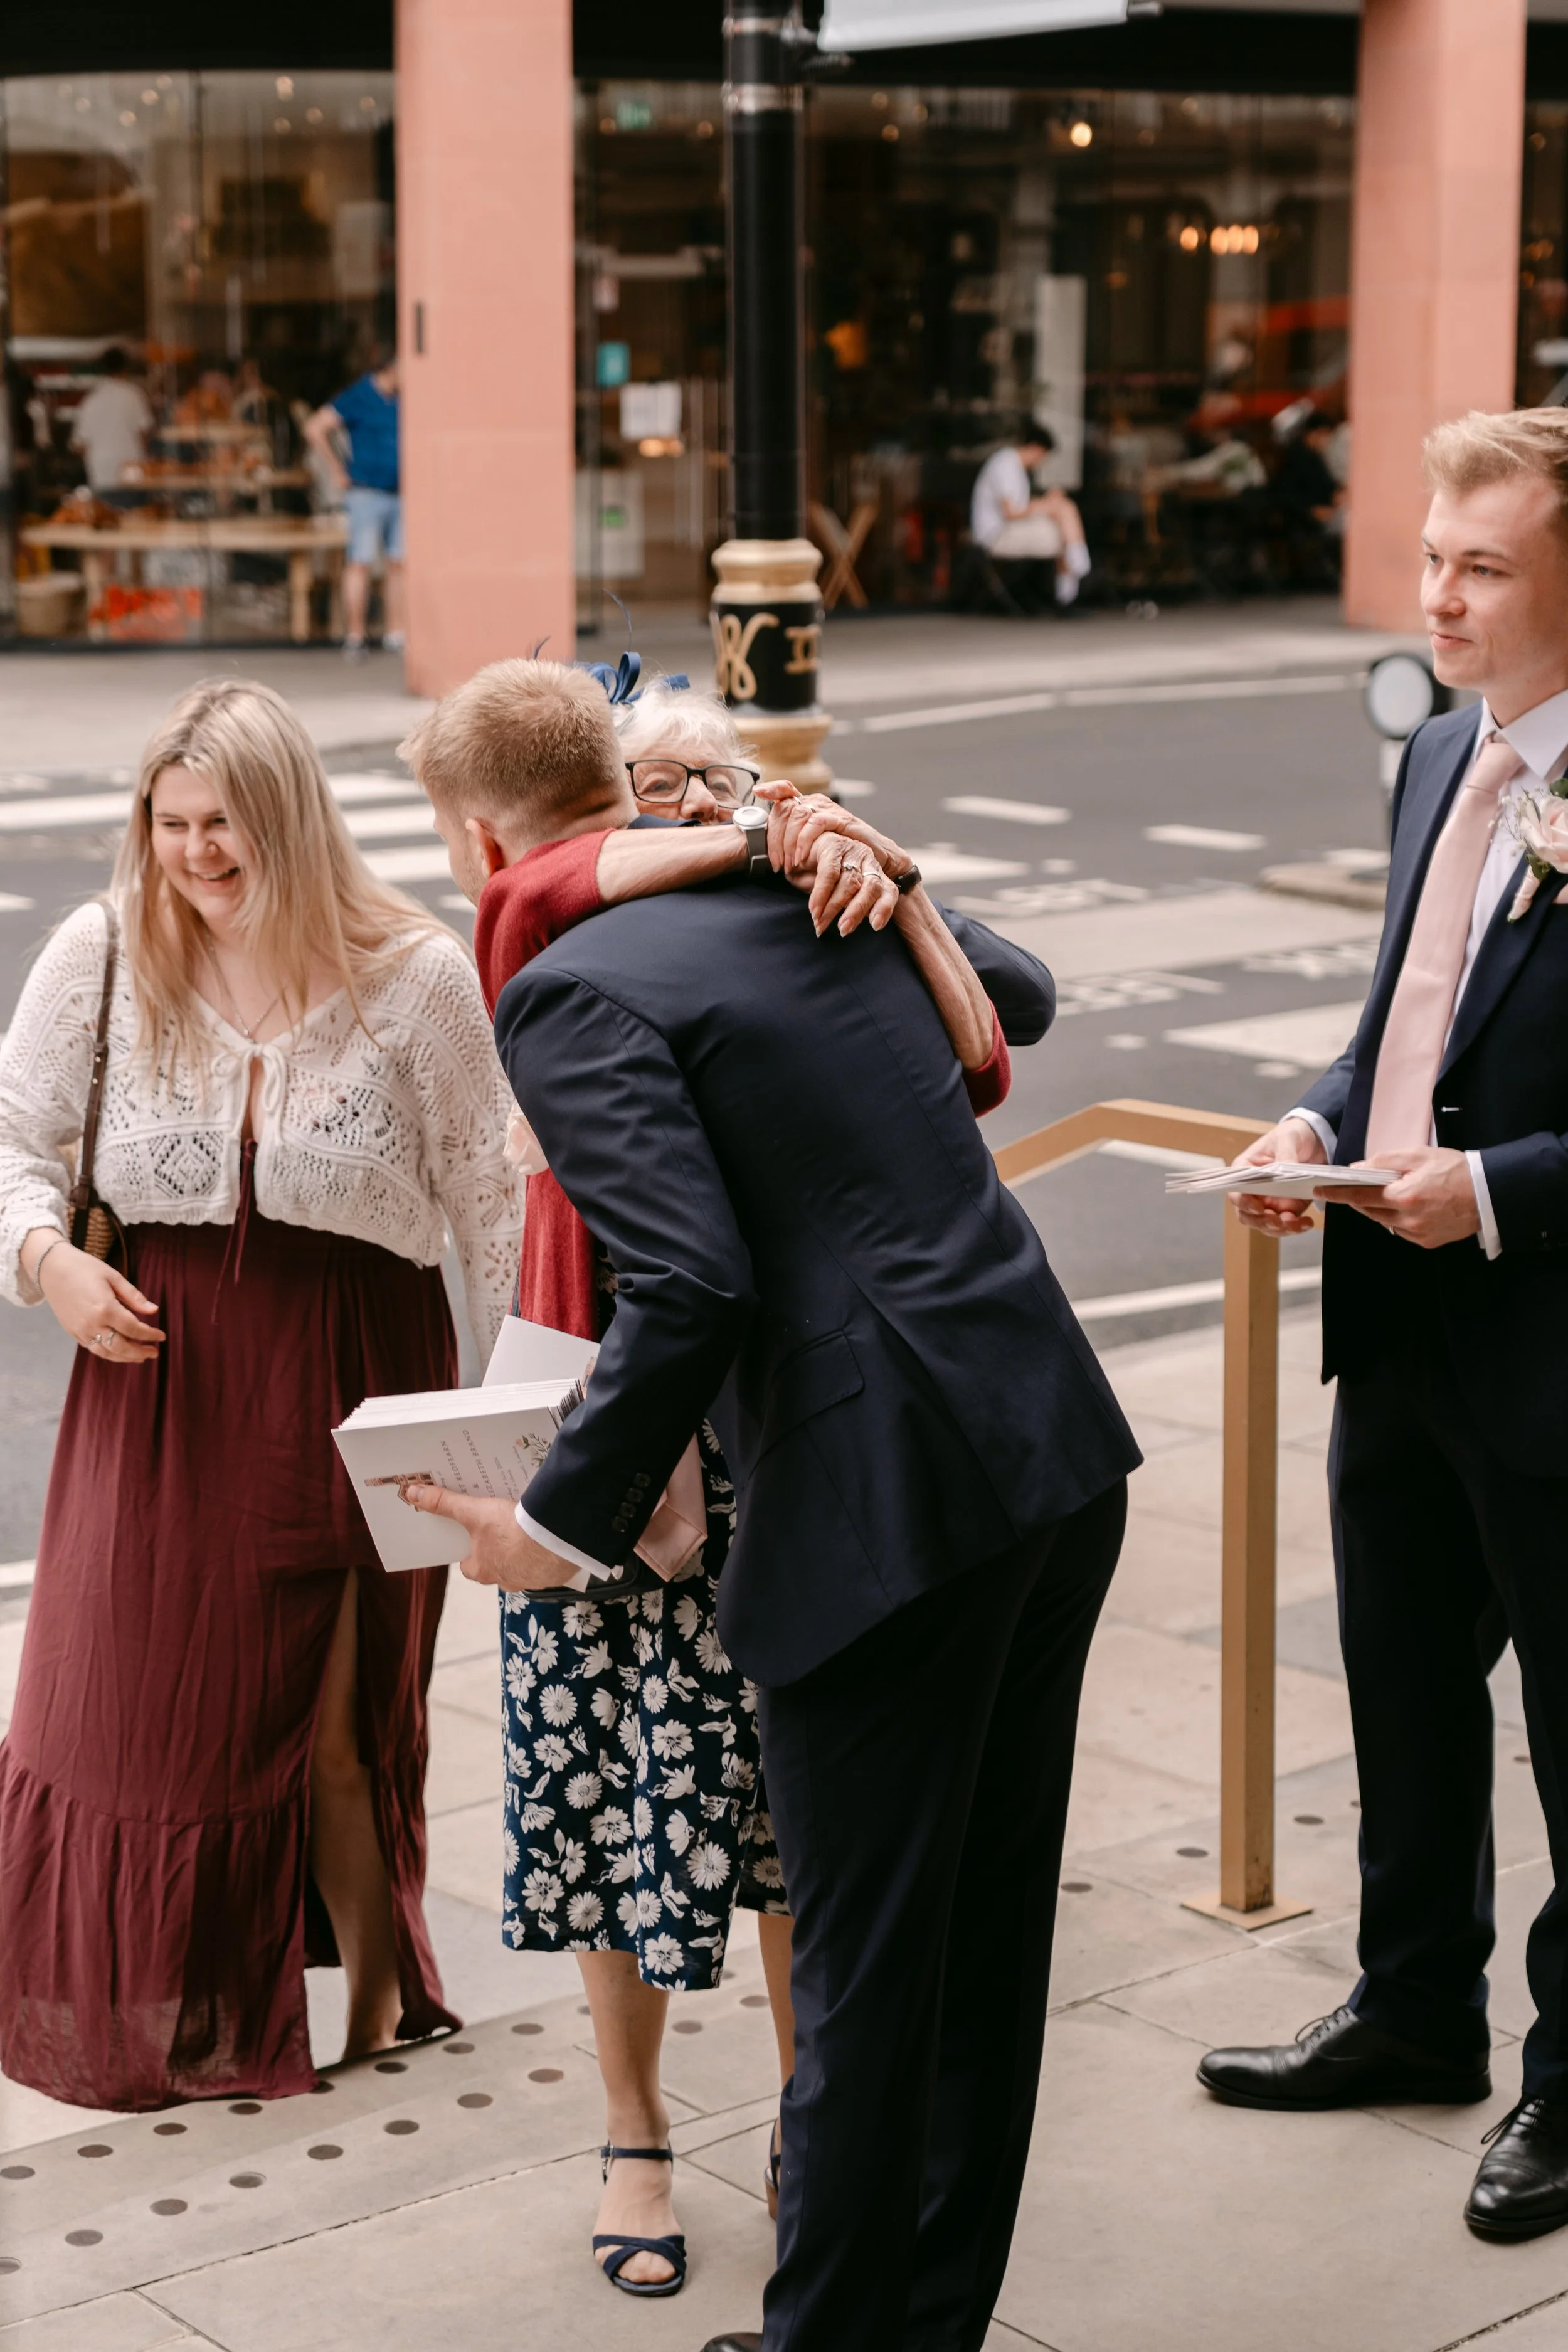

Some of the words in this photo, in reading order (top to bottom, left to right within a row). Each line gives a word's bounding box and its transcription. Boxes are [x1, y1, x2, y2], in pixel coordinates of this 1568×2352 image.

[441, 1440, 463, 1481] REDFEARN
[462, 1429, 479, 1456] BRAND
[475, 1458, 496, 1498] LIZABETH
